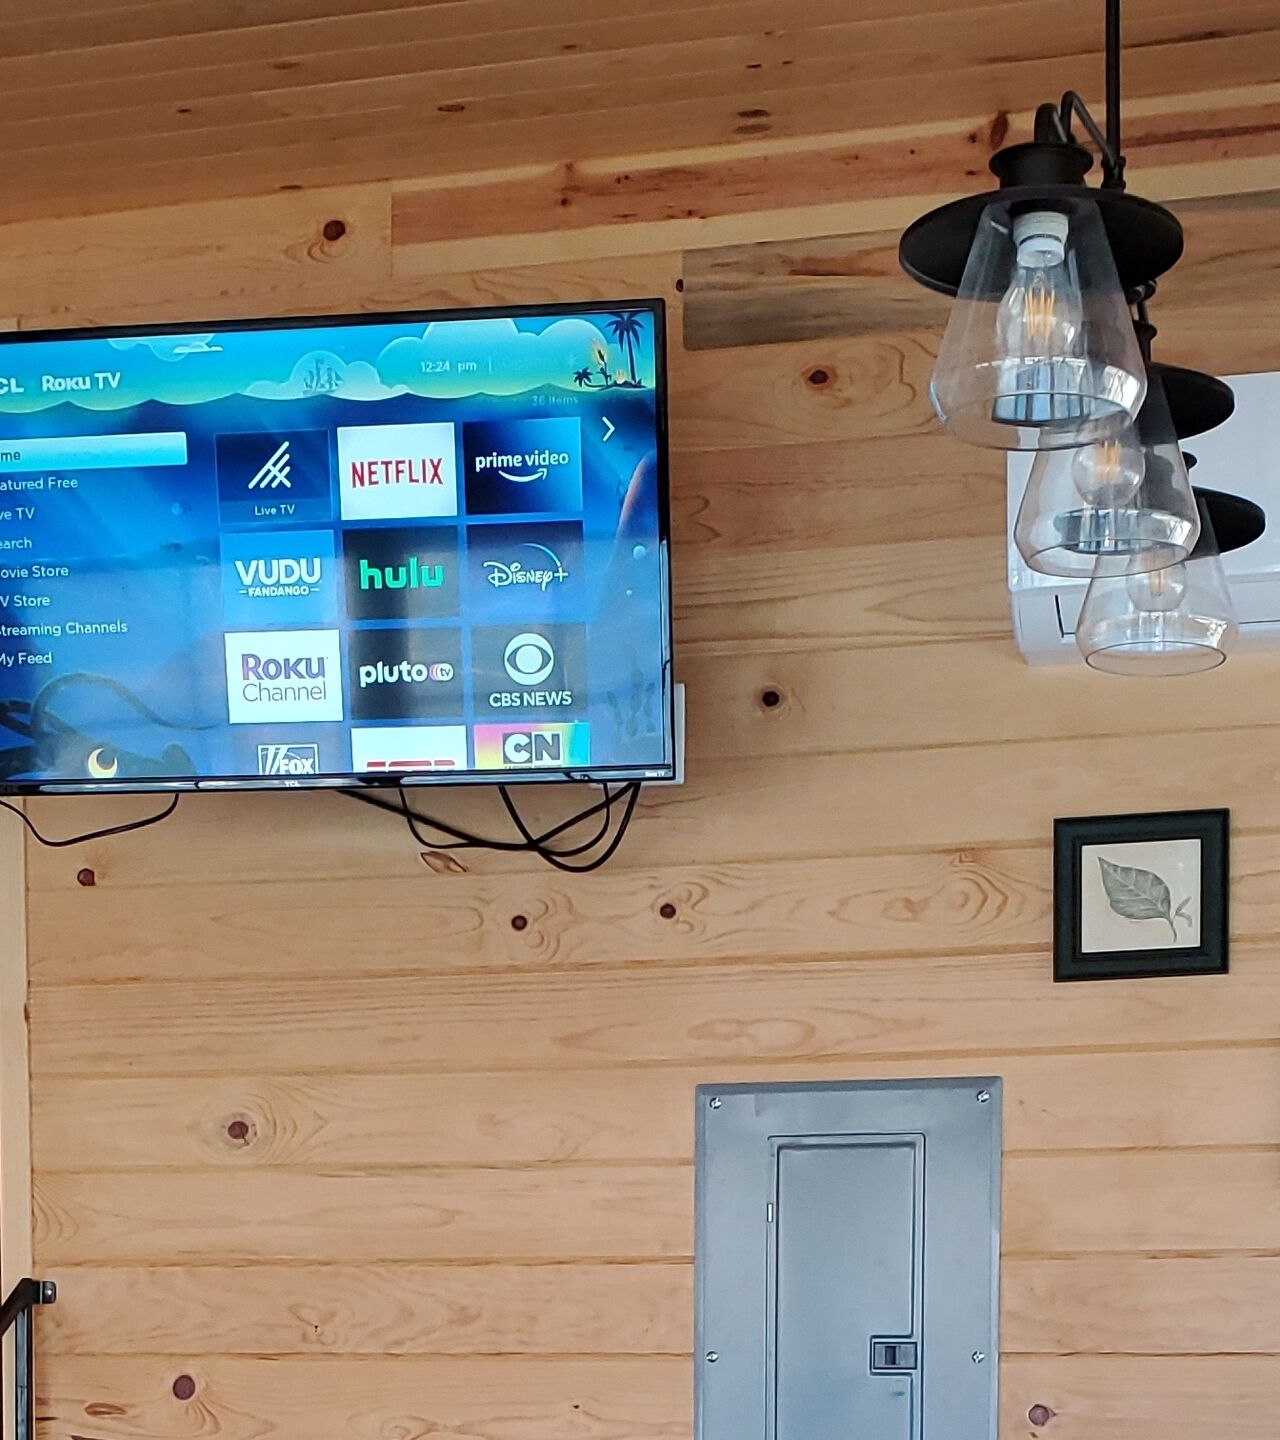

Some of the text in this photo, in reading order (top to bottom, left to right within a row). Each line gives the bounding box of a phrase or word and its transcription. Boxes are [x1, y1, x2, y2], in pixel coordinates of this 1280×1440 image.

[421, 361, 477, 375] 12:24 pm
[94, 371, 121, 390] TV
[475, 450, 569, 472] prime video
[351, 458, 444, 488] NETFLIX
[48, 477, 78, 489] Free
[15, 507, 35, 519] TV
[254, 504, 296, 516] Live TV
[31, 565, 69, 577] Store
[234, 557, 322, 586] VUDU
[359, 556, 444, 590] hulu
[247, 585, 310, 598] FANDANGO
[13, 595, 51, 607] Store
[65, 620, 128, 634] Channels
[18, 651, 53, 664] Feed
[242, 681, 327, 702] Channel
[488, 690, 573, 708] CBS NEWS
[503, 732, 562, 764] CN
[279, 757, 314, 775] FOX
